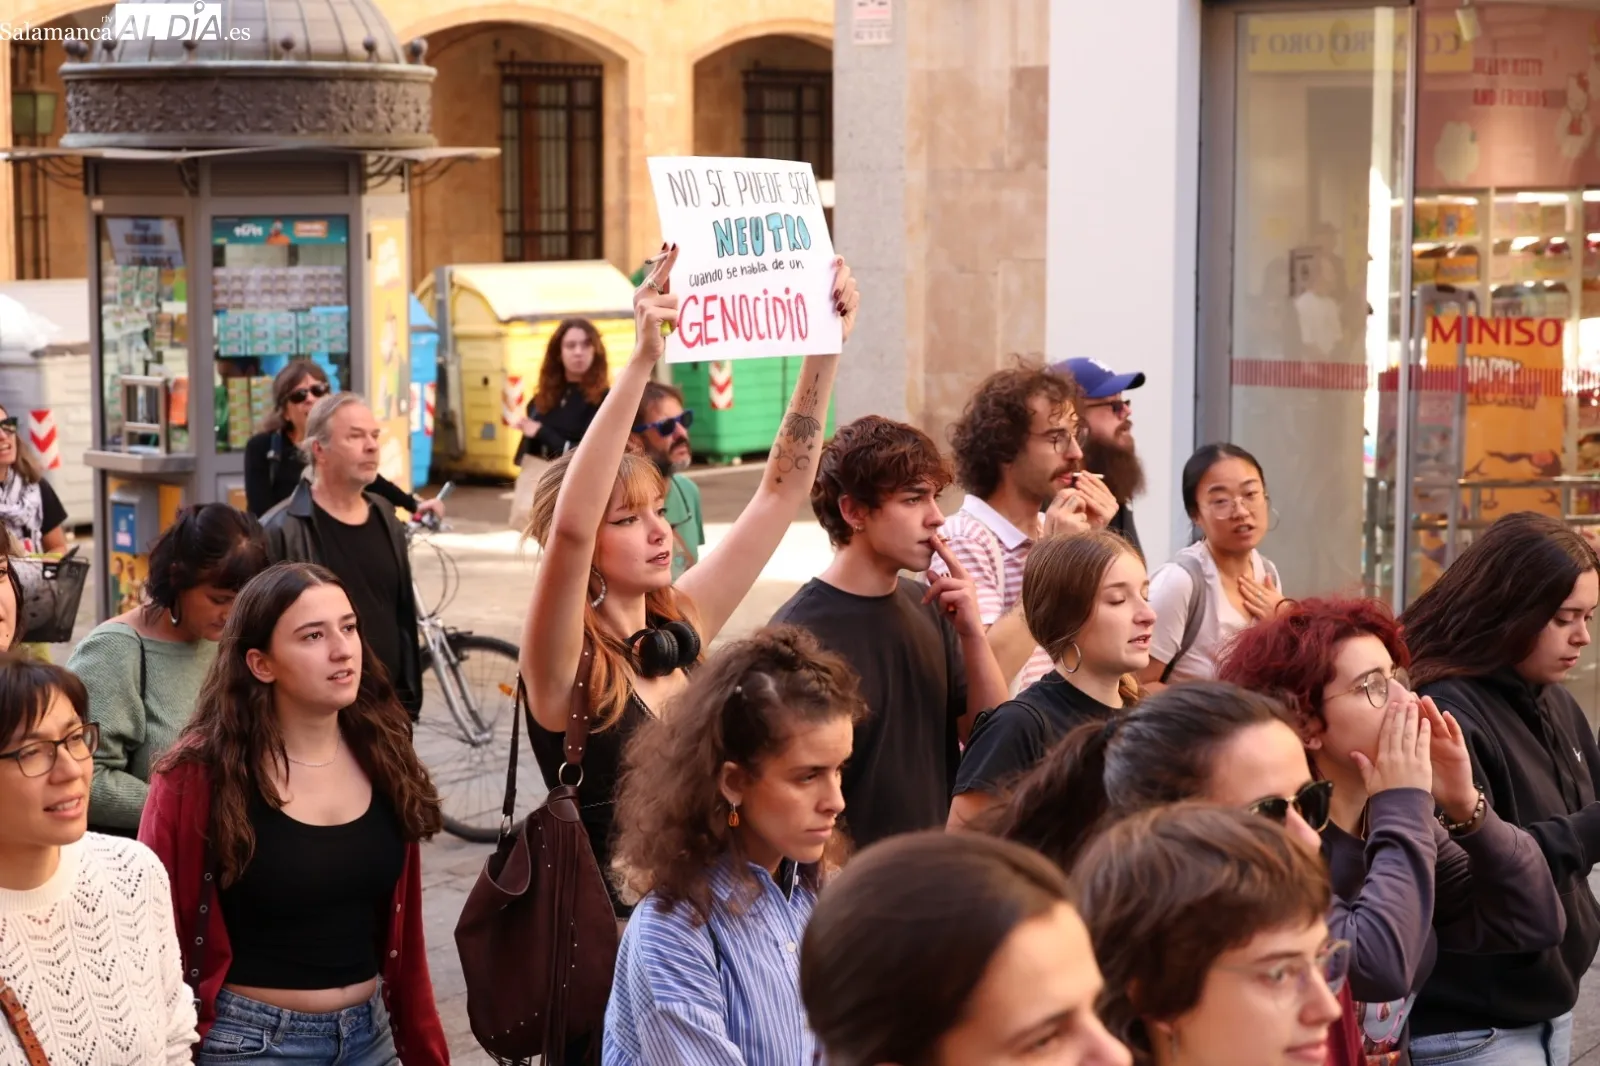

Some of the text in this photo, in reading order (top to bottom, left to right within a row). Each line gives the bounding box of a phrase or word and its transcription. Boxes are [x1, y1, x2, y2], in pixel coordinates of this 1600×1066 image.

[667, 169, 815, 208] NO SE PUEDE SER
[712, 212, 811, 259] NEUTRO
[726, 266, 738, 280] se
[772, 258, 785, 270] de
[789, 259, 804, 270] un
[1431, 315, 1562, 347] MINISO
